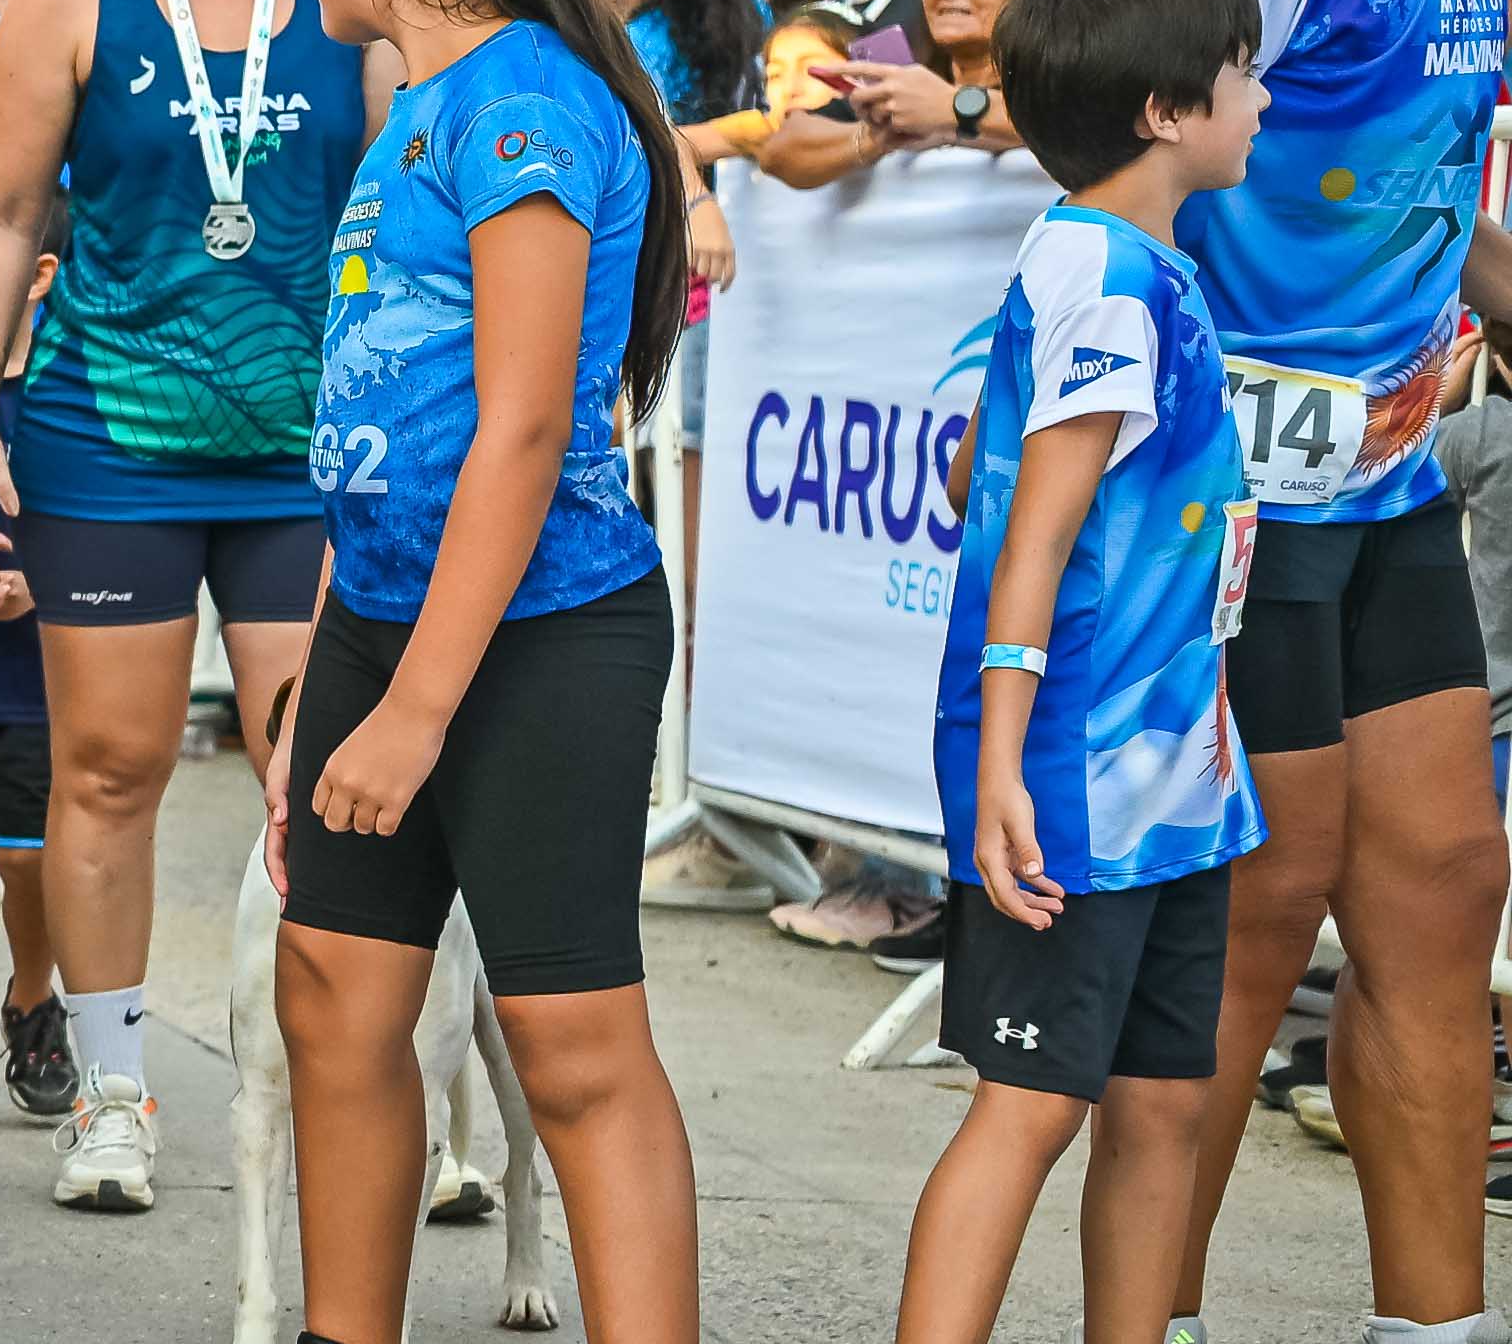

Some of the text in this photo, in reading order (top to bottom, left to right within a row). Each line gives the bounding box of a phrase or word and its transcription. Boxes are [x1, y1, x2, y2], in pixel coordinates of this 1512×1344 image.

[1440, 15, 1493, 35] HÉROES
[1064, 351, 1114, 383] MDXT
[745, 390, 971, 554] CARUS
[1279, 478, 1328, 492] CARUSO
